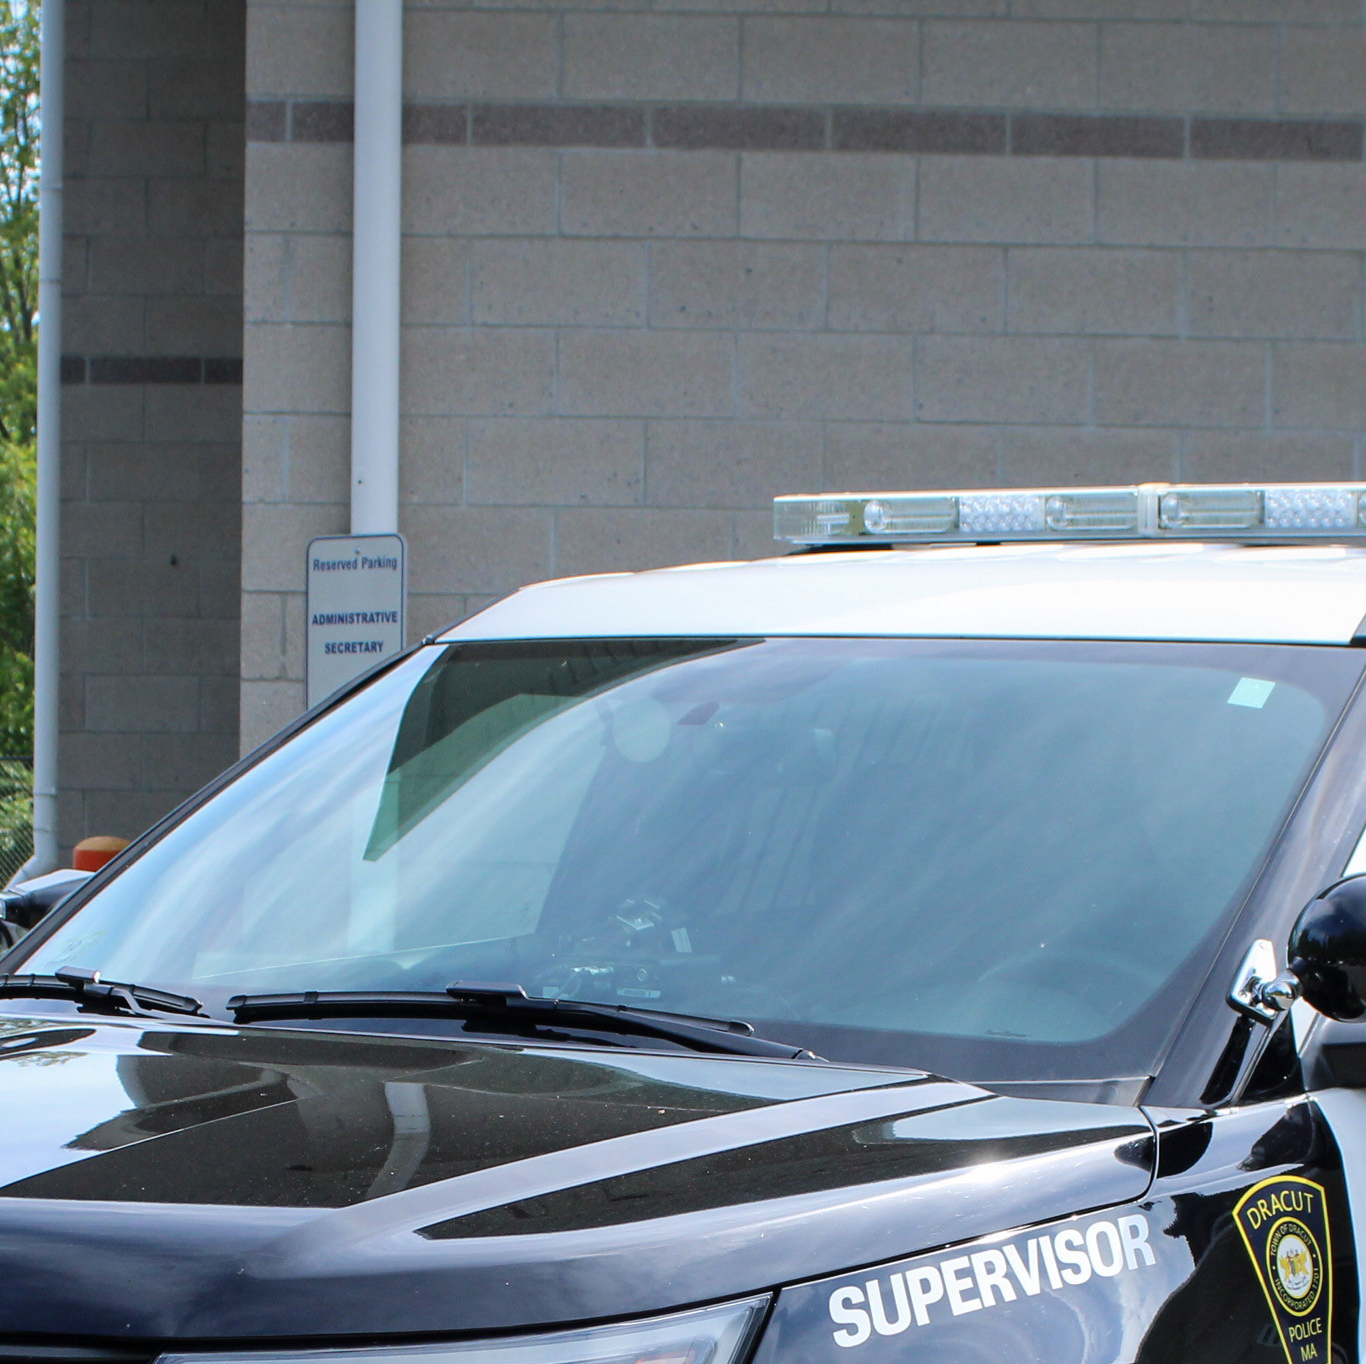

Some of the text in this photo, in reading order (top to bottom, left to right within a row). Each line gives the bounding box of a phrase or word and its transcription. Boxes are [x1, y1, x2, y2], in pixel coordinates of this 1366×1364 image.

[313, 556, 398, 572] Reserved Parking
[312, 611, 398, 626] ADMINISTRATIVE
[324, 640, 384, 655] SECRETARY
[1246, 1190, 1314, 1230] DRACUT
[1270, 1223, 1312, 1257] TOWN OF DRACUT
[828, 1214, 1156, 1348] SUPERVISOR
[1288, 1317, 1323, 1342] POLICE
[1300, 1343, 1318, 1362] MA
